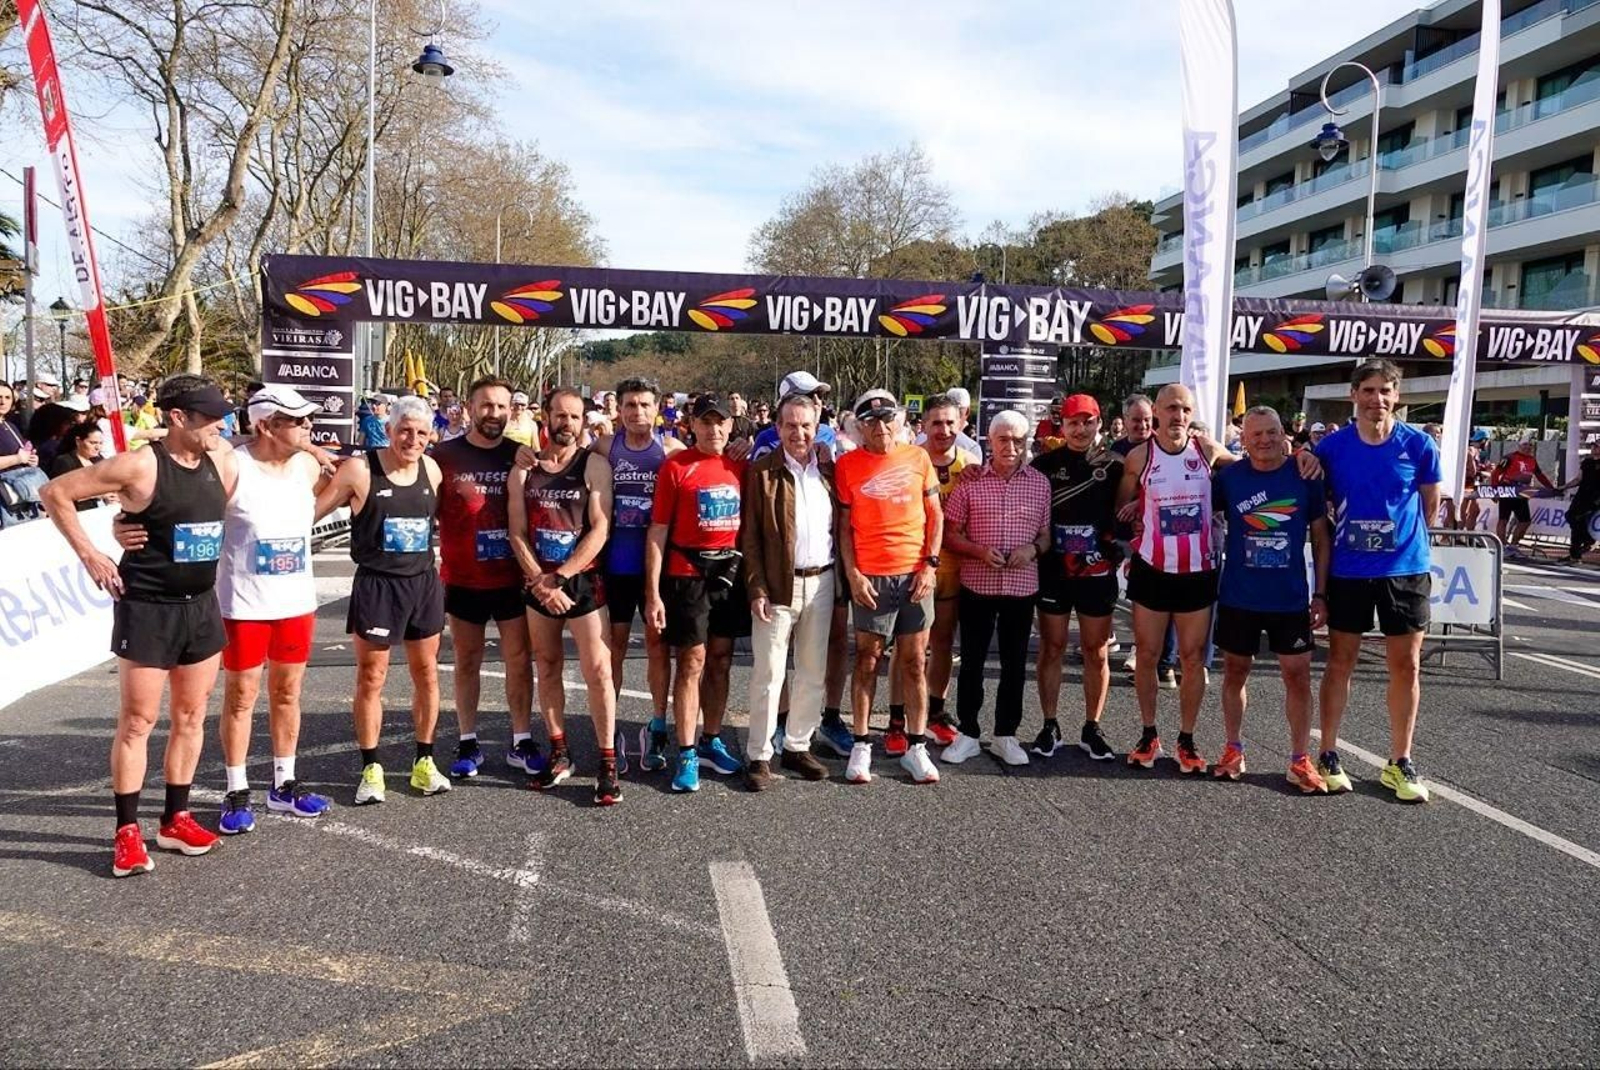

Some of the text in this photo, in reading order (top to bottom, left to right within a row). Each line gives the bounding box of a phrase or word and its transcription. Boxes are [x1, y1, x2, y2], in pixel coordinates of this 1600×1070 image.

[365, 279, 488, 320] VIG BAY
[569, 288, 686, 327] VIG BAY
[765, 295, 876, 333] VIG BAY
[956, 295, 1092, 344] VIG BAY
[1164, 312, 1183, 346] VI
[1328, 318, 1425, 356] VIG BAY
[272, 333, 322, 344] VIEIRAS
[1487, 326, 1580, 362] VIG BAY
[282, 364, 338, 379] ABANCA
[1365, 535, 1383, 549] 12
[267, 556, 300, 571] 1951
[0, 563, 112, 647] BANC
